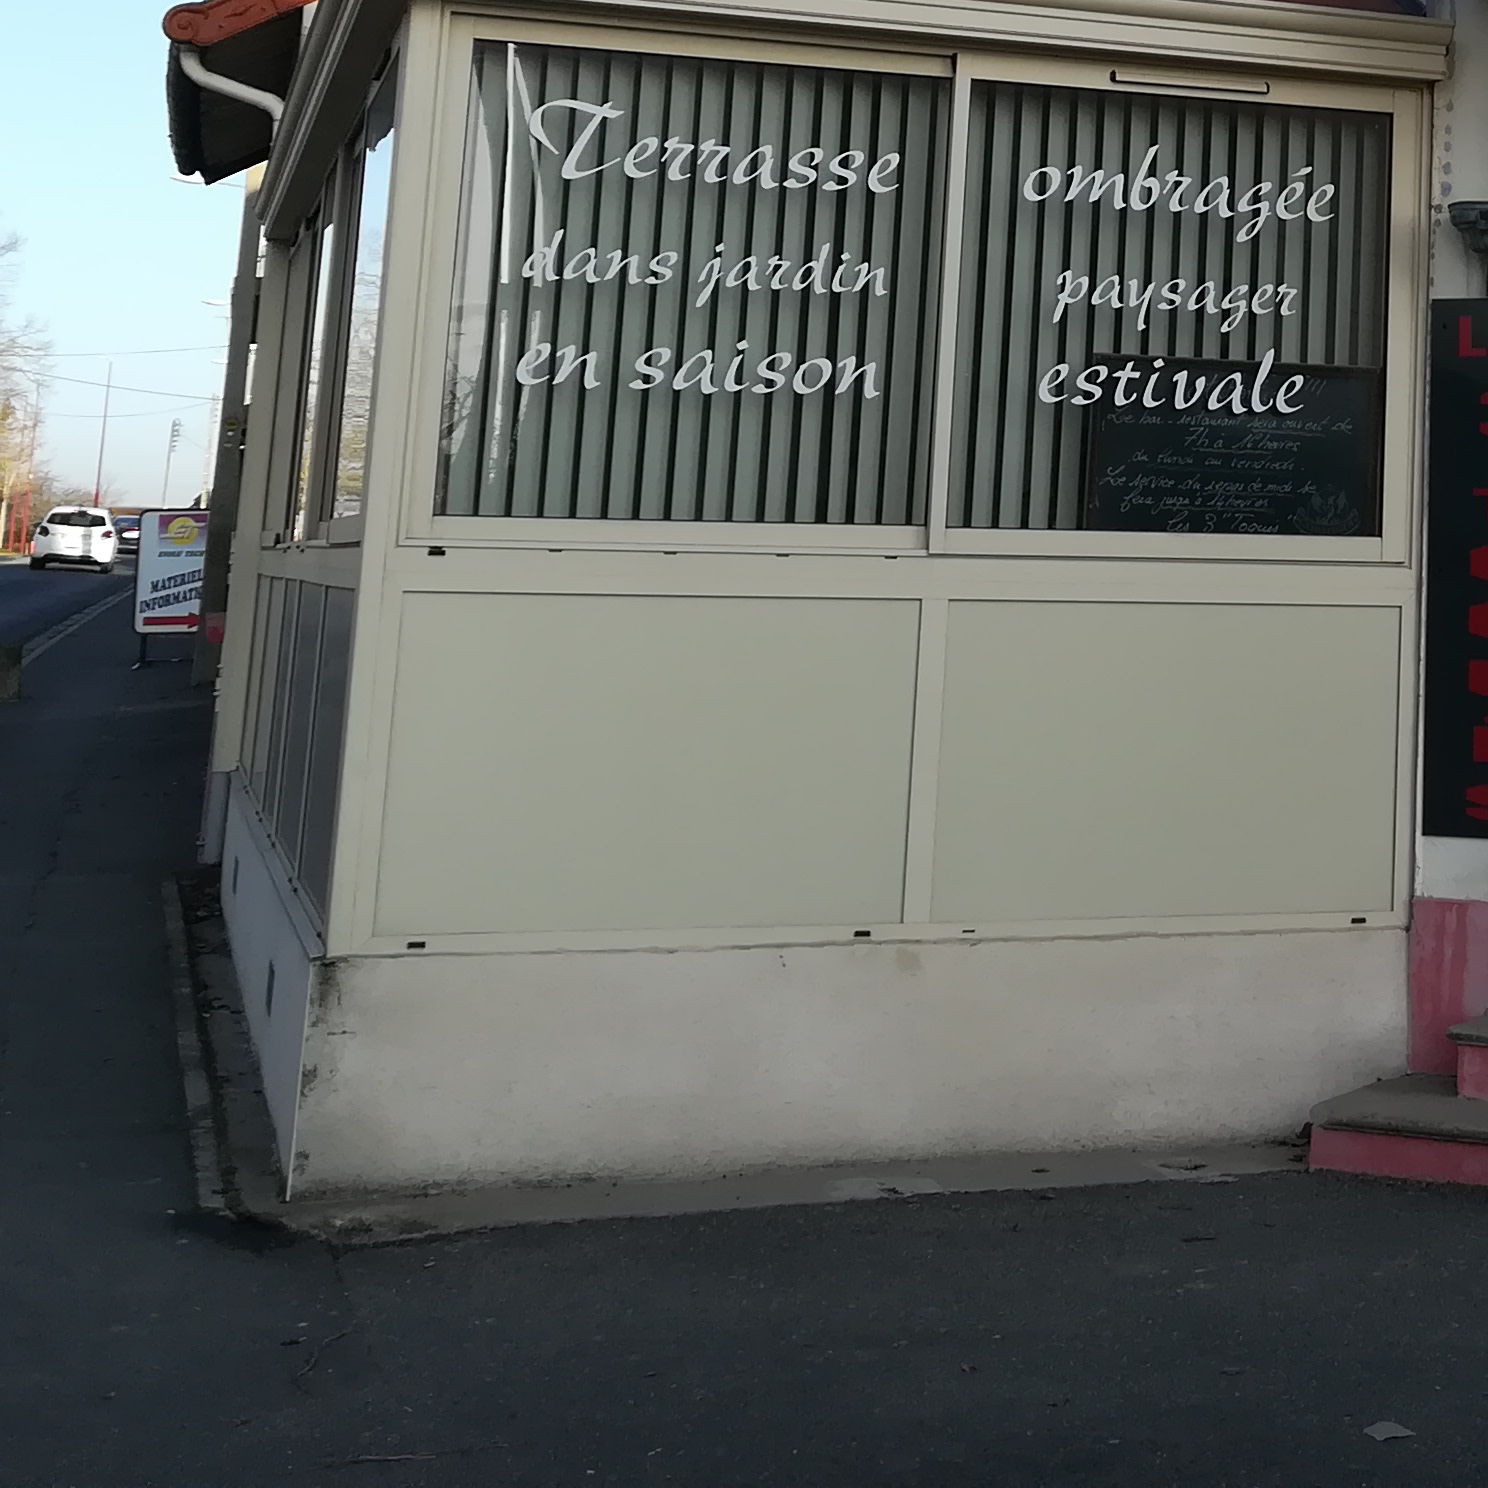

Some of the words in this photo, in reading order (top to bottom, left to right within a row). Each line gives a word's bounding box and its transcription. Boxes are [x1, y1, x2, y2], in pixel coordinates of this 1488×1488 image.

[528, 99, 900, 194] Terrasse
[1022, 144, 1336, 243] ombragée
[521, 228, 680, 287] dans
[695, 242, 888, 308] jardin
[1053, 269, 1298, 333] paysager
[515, 341, 601, 390] en
[629, 340, 880, 400] saison
[1037, 348, 1305, 415] estivale
